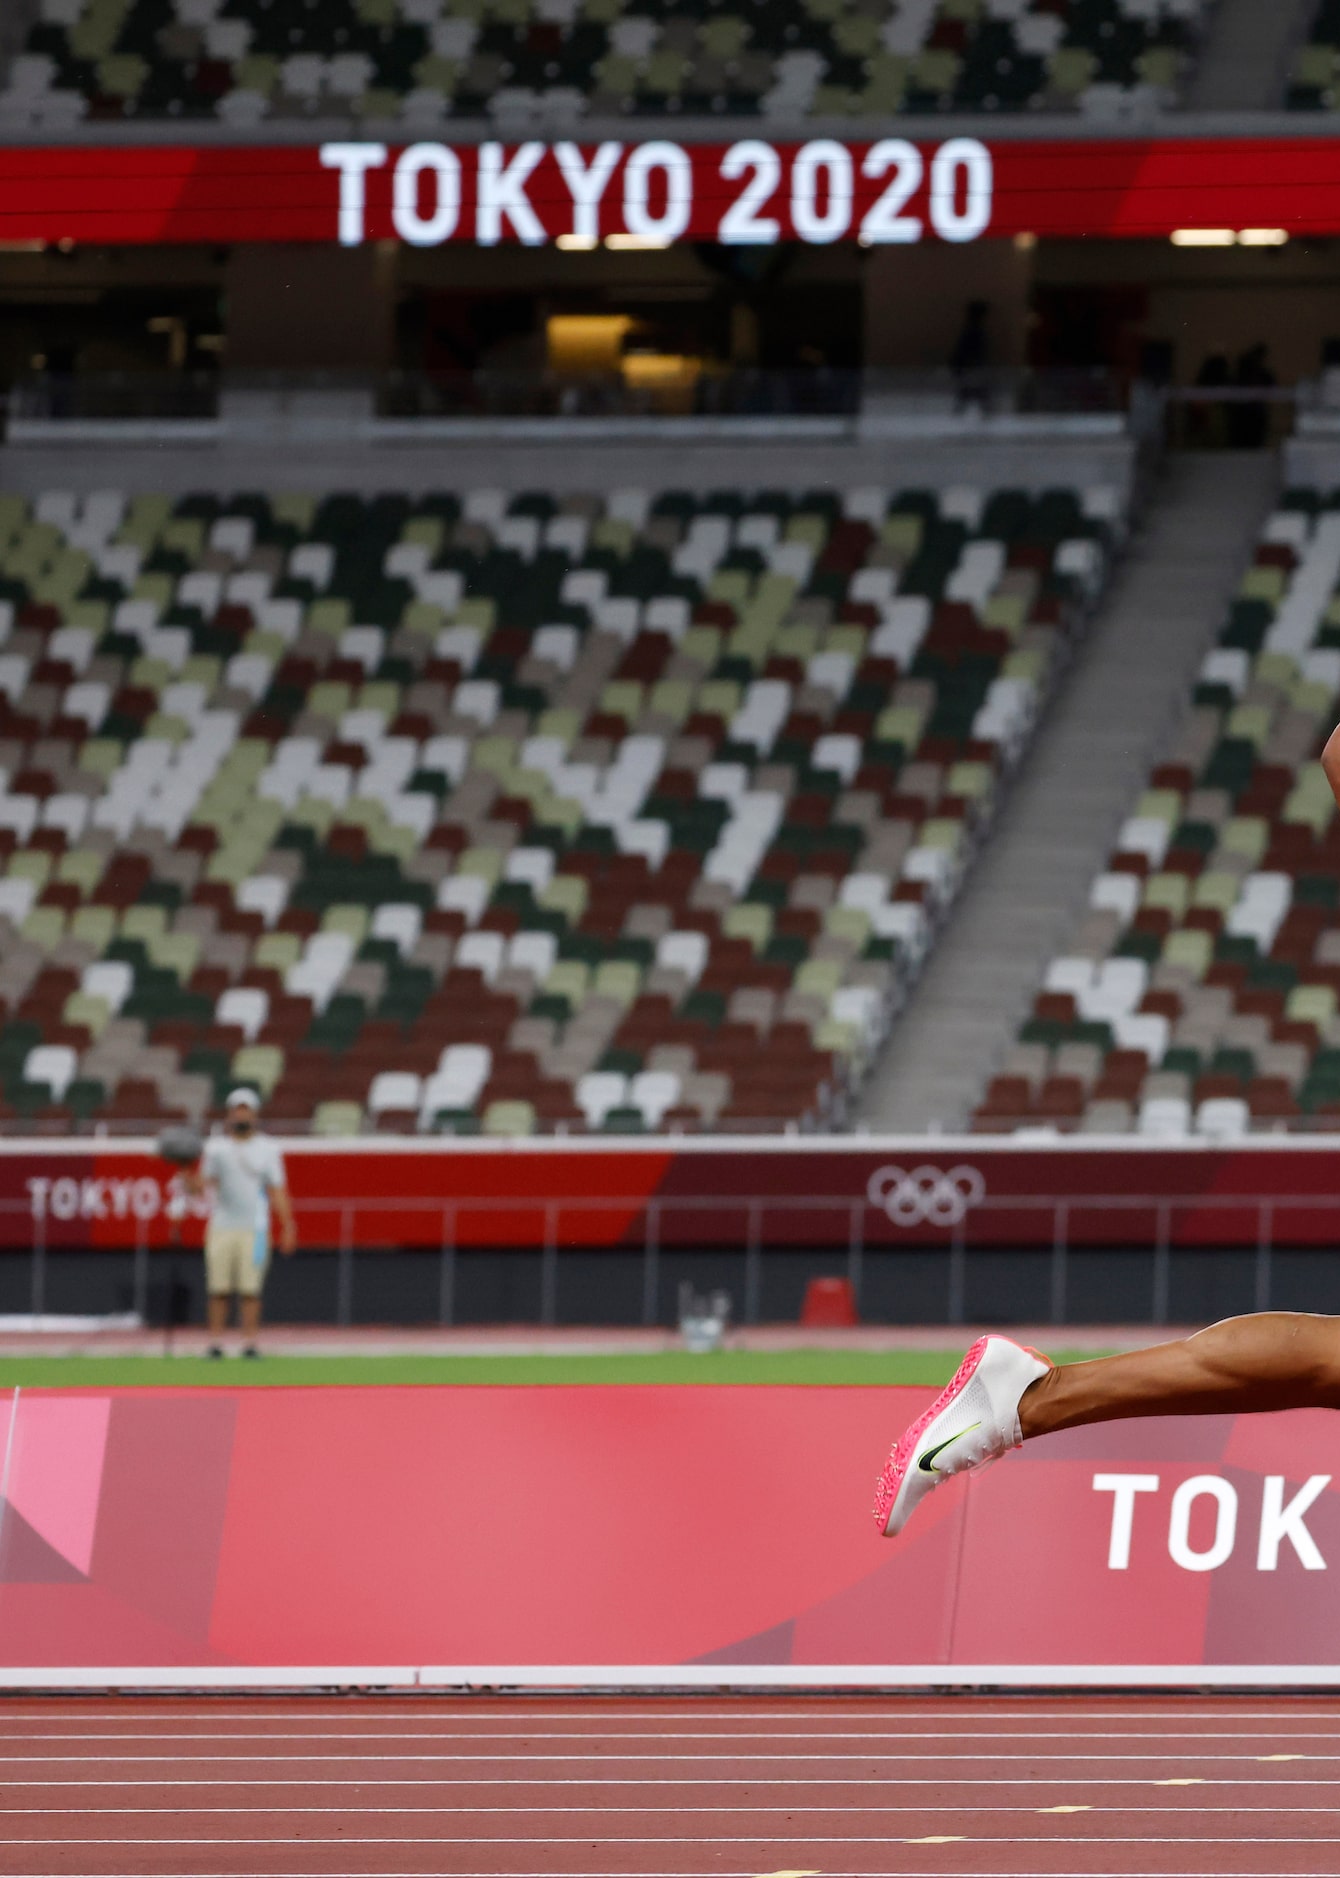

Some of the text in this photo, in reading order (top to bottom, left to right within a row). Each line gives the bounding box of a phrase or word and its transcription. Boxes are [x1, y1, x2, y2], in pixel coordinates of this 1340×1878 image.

[319, 138, 994, 246] TOKYO 2020
[26, 1176, 162, 1221] TOKYO
